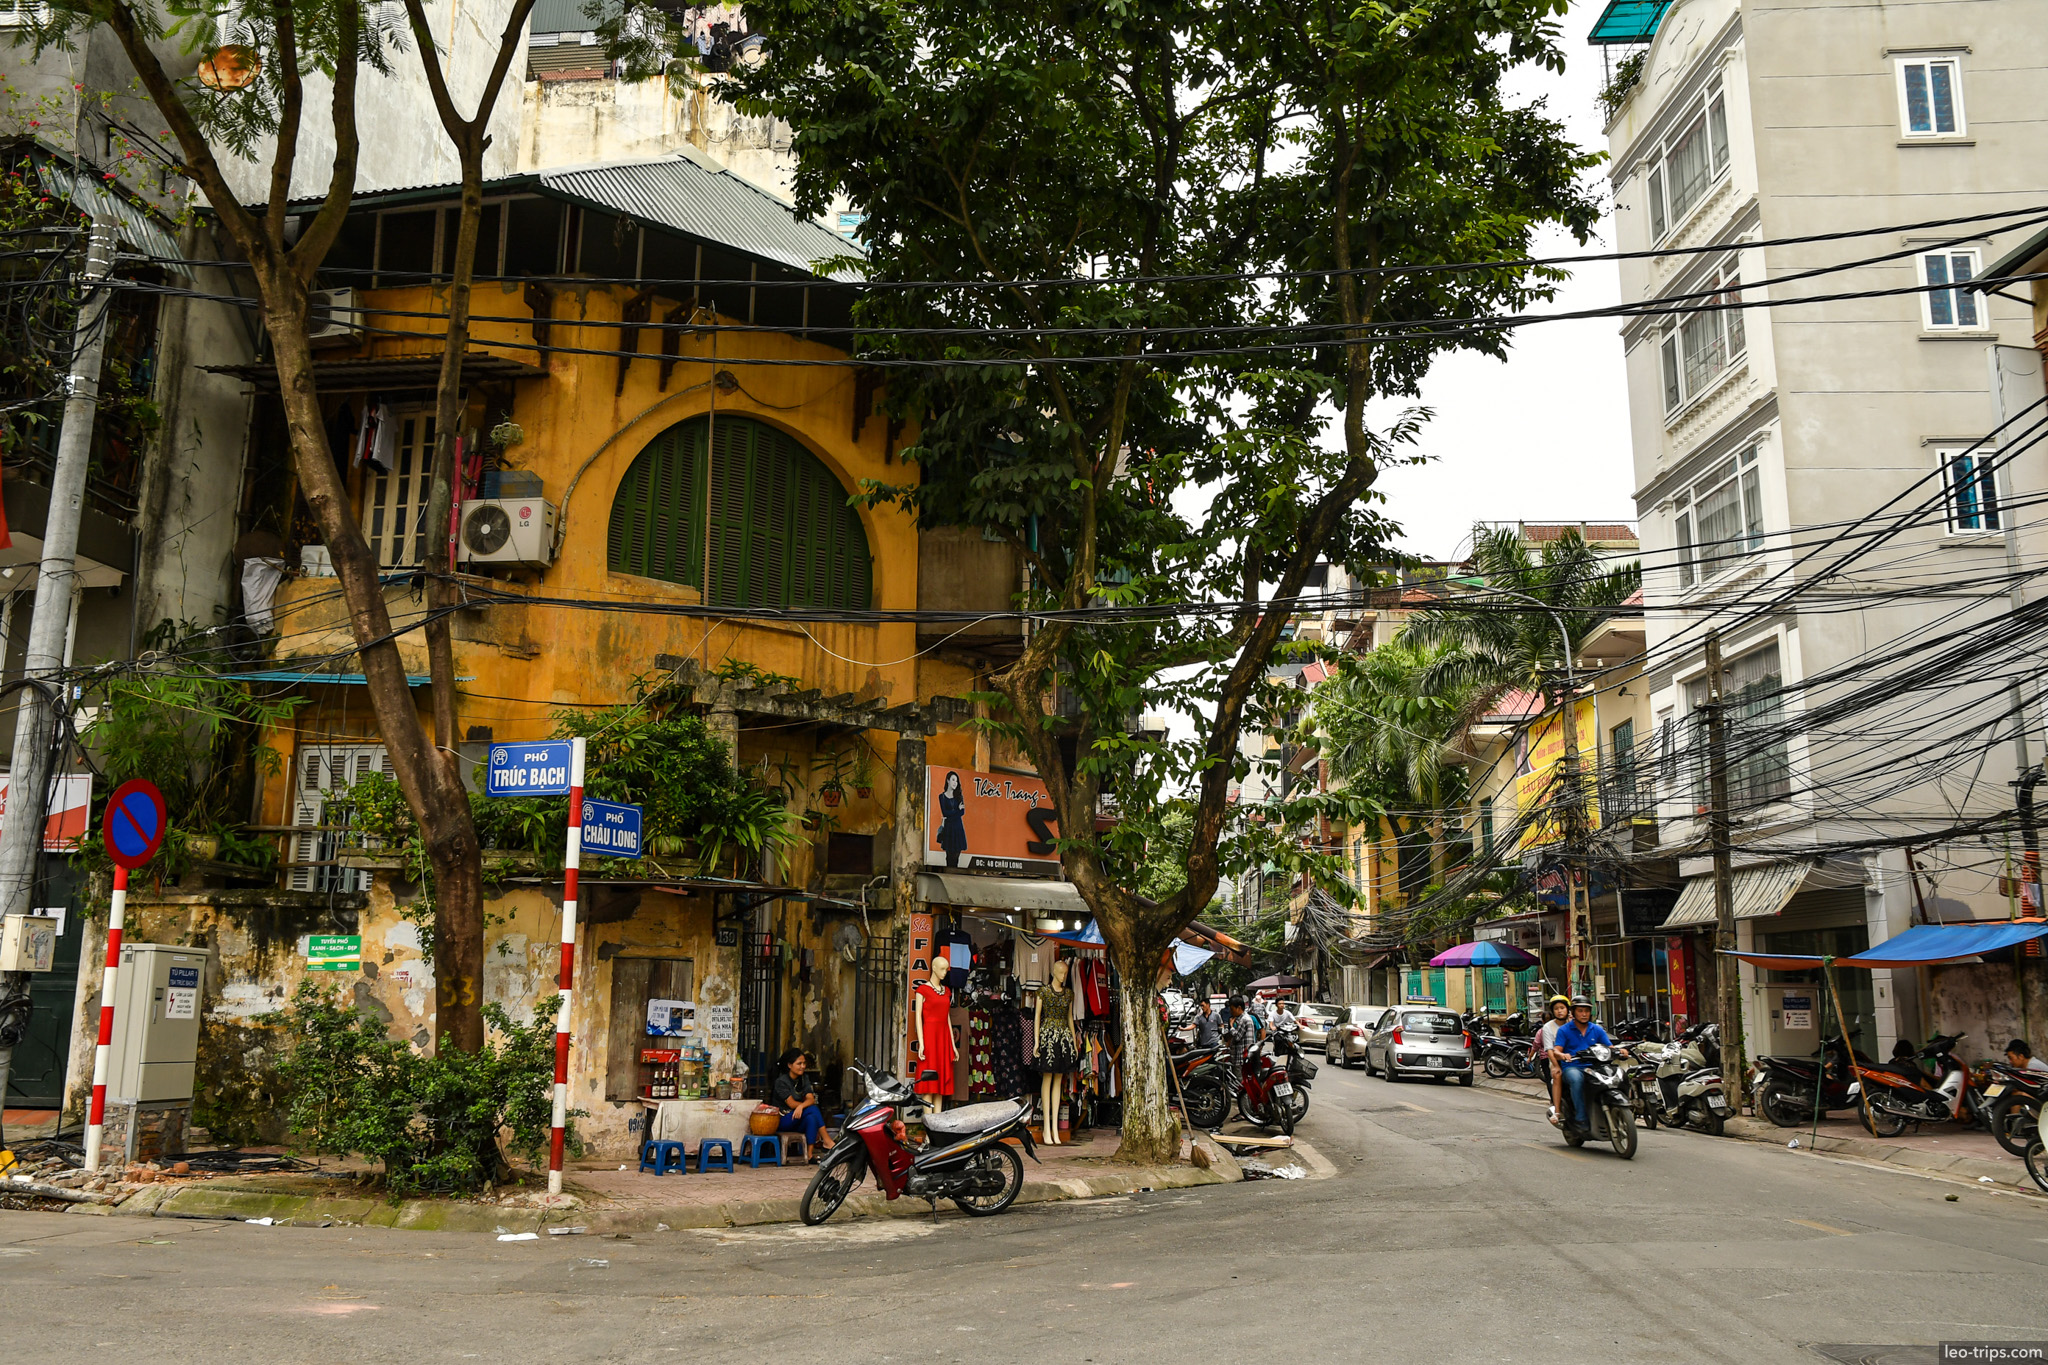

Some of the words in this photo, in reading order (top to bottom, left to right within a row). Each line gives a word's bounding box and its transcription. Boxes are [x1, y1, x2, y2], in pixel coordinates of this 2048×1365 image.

[524, 749, 549, 762] PHỐ
[494, 765, 527, 787] TRÚC
[530, 767, 566, 789] BẠCH
[974, 778, 1002, 798] Thời
[1004, 781, 1039, 808] Trang
[605, 811, 625, 824] PHỐ
[584, 823, 611, 846] CHÂU
[612, 828, 637, 849] LONG
[995, 860, 1009, 868] CHÂU
[1009, 861, 1023, 869] LONG
[912, 918, 931, 933] She
[320, 937, 337, 945] TUYẾN
